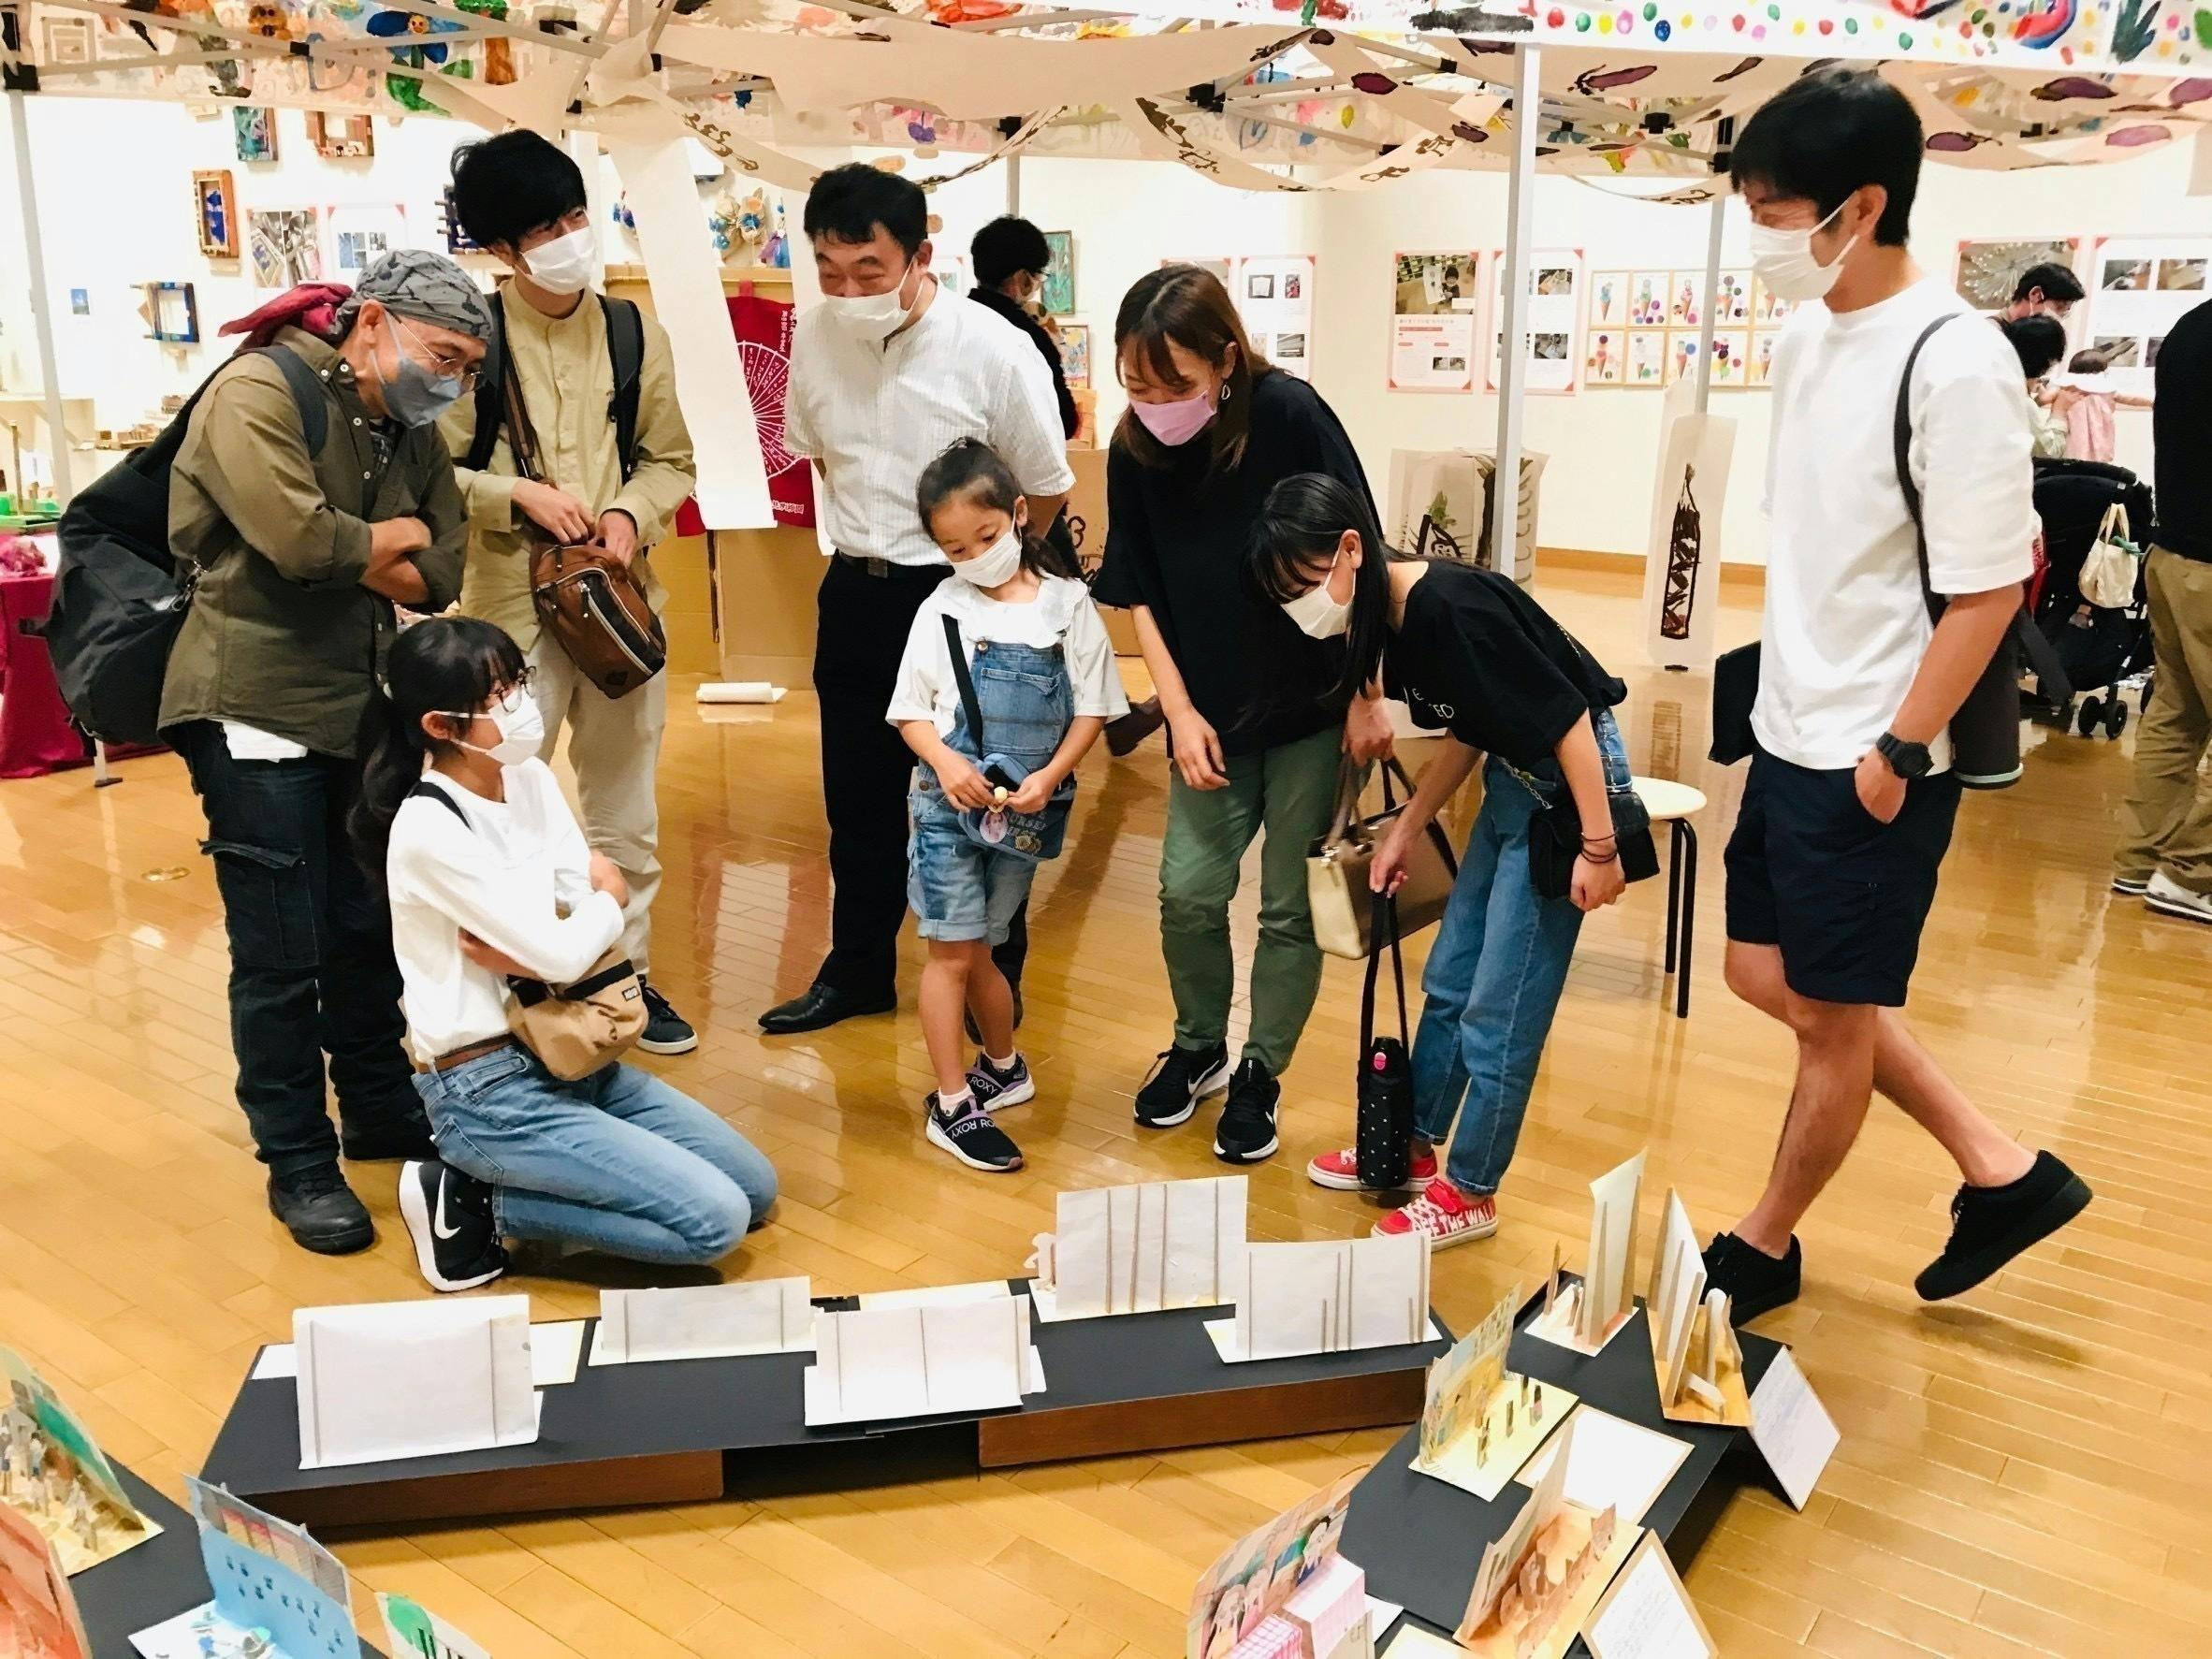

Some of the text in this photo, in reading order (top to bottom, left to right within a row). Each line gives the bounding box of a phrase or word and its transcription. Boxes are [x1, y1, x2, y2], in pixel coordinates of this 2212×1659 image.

[1428, 703, 1455, 720] ED
[970, 1077, 997, 1094] ROXY
[951, 1119, 977, 1139] ROXY
[1438, 1212, 1466, 1234] THE
